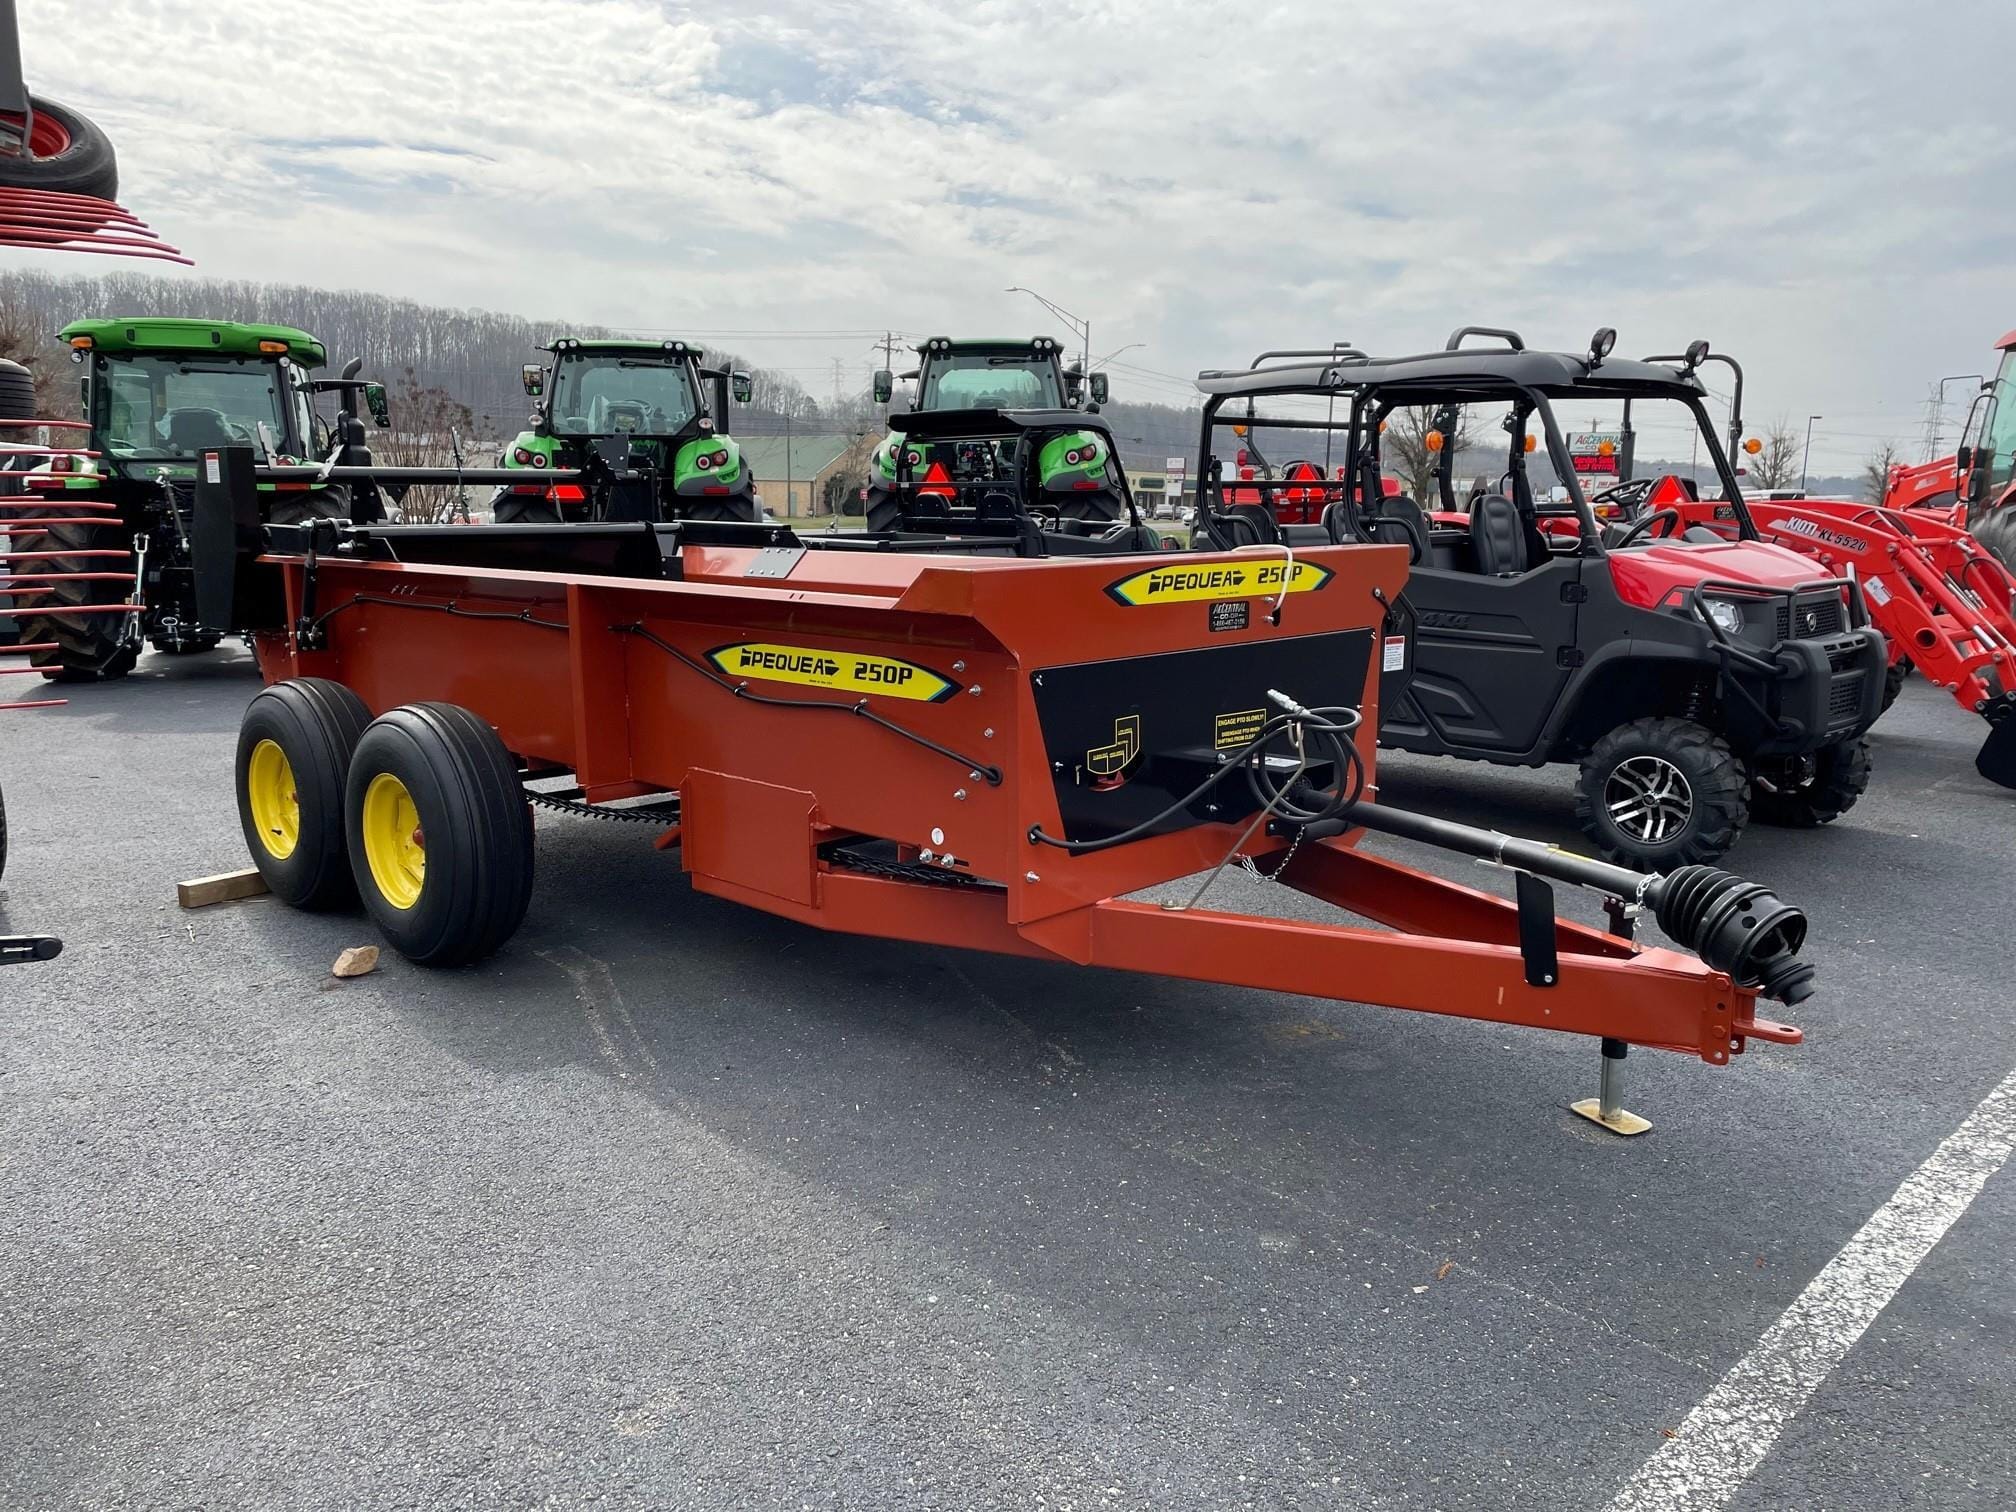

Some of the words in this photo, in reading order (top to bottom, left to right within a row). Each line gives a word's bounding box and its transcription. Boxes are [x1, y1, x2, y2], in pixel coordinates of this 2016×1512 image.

[1786, 516, 1818, 536] KIOTI
[1160, 572, 1234, 592] PEQUEA
[751, 652, 825, 676] PEQUEA
[854, 662, 912, 685] 250P
